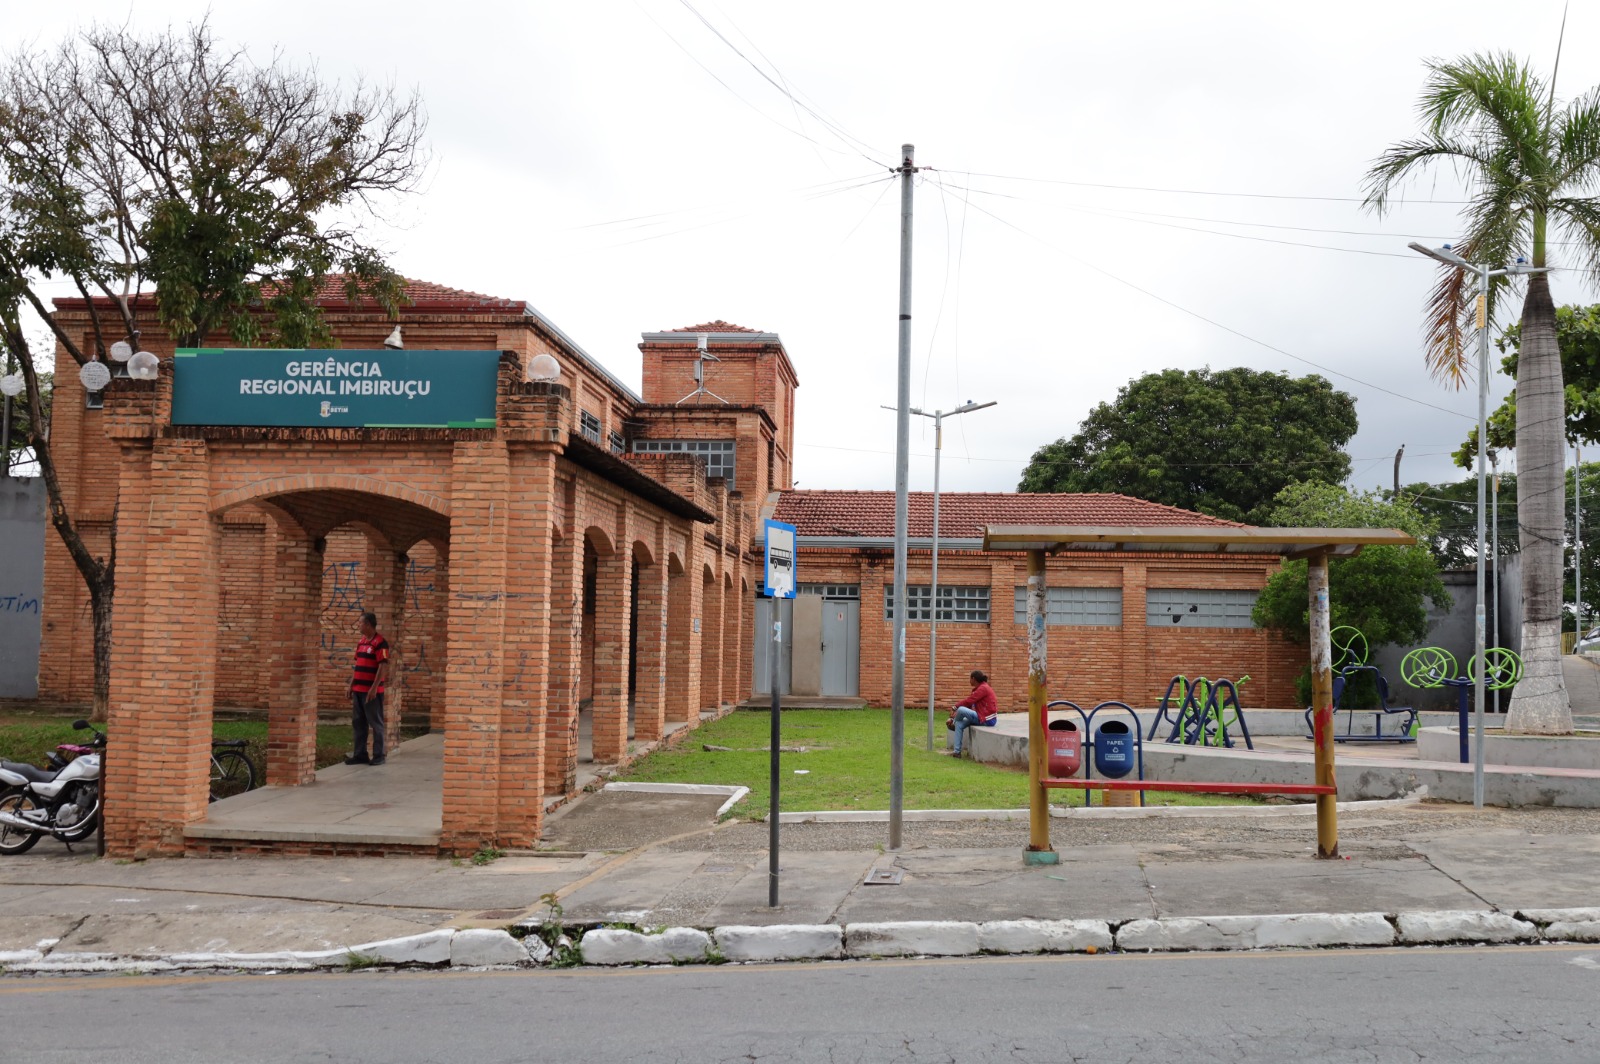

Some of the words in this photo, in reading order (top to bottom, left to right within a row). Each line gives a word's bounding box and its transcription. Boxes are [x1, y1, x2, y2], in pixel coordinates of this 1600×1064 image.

[286, 357, 382, 377] GERÊNCIA
[240, 379, 336, 395] REGIONAL
[339, 380, 431, 399] IMBIRUÇU
